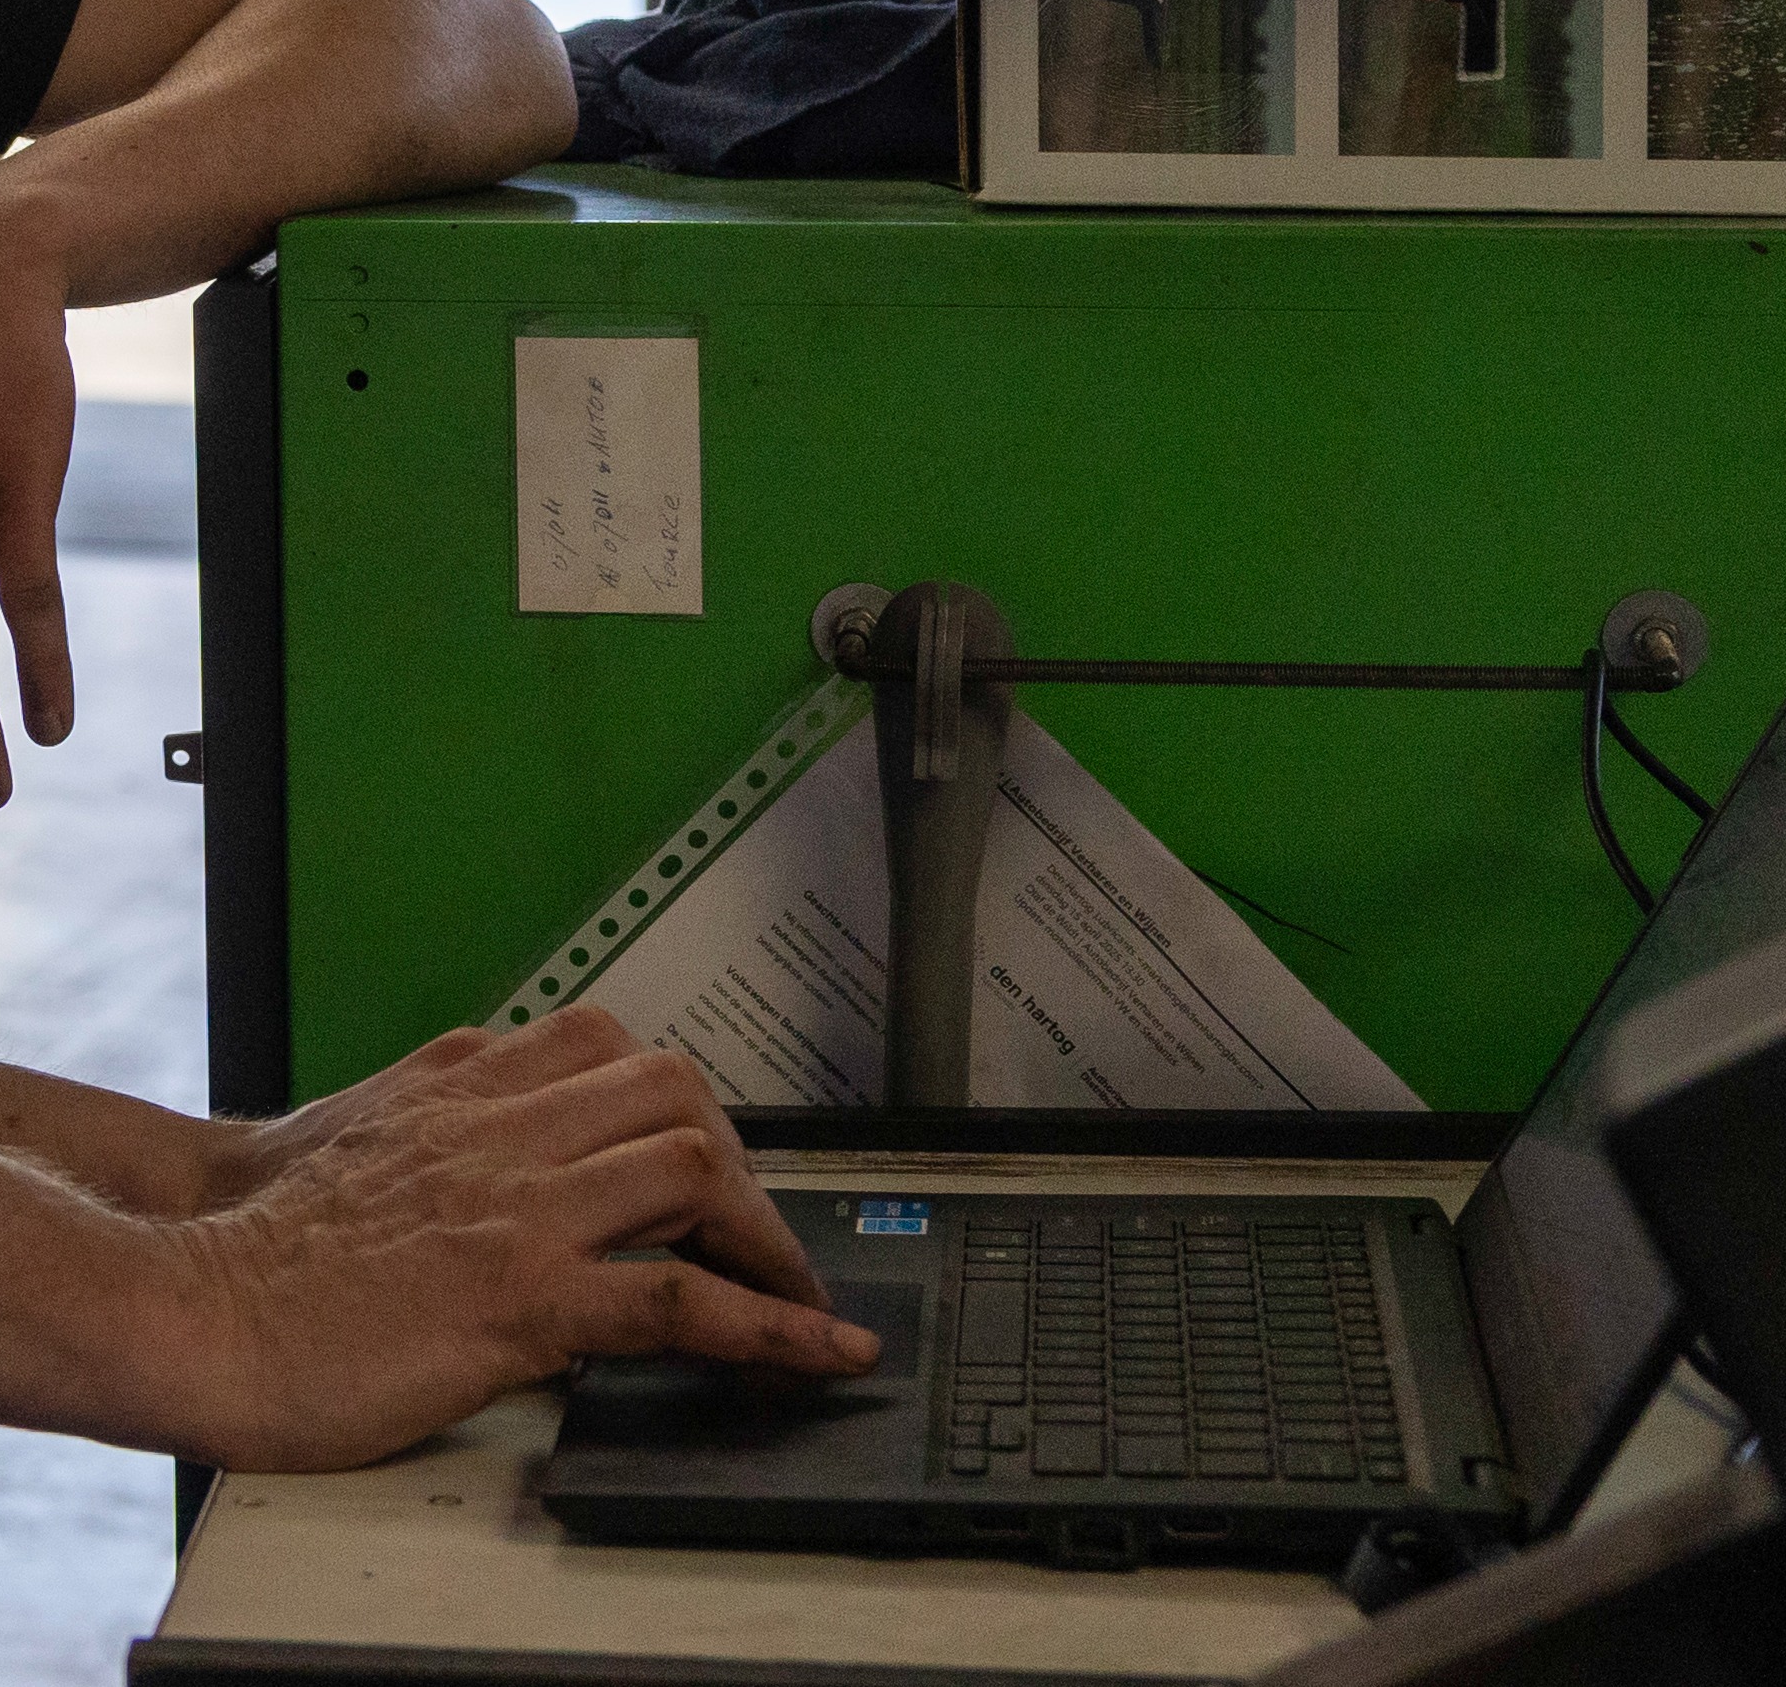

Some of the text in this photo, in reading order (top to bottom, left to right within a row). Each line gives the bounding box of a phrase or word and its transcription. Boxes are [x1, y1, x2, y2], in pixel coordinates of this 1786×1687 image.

[802, 888, 844, 928] Geachte
[1008, 783, 1071, 848] Autobedrijf
[1069, 844, 1119, 895] Verharen
[1117, 894, 1133, 910] en
[1130, 908, 1172, 951] Wijnen
[1033, 873, 1070, 910] dinsdag
[1068, 907, 1082, 921] 15
[1078, 919, 1101, 942] april
[768, 923, 818, 970] Volkswagen
[781, 909, 796, 925] Wij
[1047, 864, 1066, 883] Den
[1063, 882, 1095, 915] Hartog
[1093, 912, 1137, 956] Lubricants
[711, 980, 730, 999] Voor
[728, 996, 742, 1009] de
[988, 962, 1024, 999] den
[1019, 995, 1077, 1056] hartog
[1012, 893, 1045, 927] Update
[1112, 997, 1130, 1015] VW
[1127, 1015, 1140, 1028] en
[1139, 1026, 1178, 1066] Stellantis
[1041, 901, 1056, 916] de
[1054, 914, 1079, 939] Wildt
[1080, 942, 1129, 993] Autobedrijf
[1126, 990, 1167, 1032] Verharen
[1163, 1029, 1176, 1043] en
[1174, 1042, 1206, 1075] Wijnen
[666, 1024, 746, 1100] De volgende normen
[697, 992, 815, 1104] voorschriften zijn afgeleid van de
[723, 965, 782, 1020] Volkswagen
[778, 1016, 853, 1087] Bedrijfswagens
[1080, 1071, 1116, 1109] Distribut
